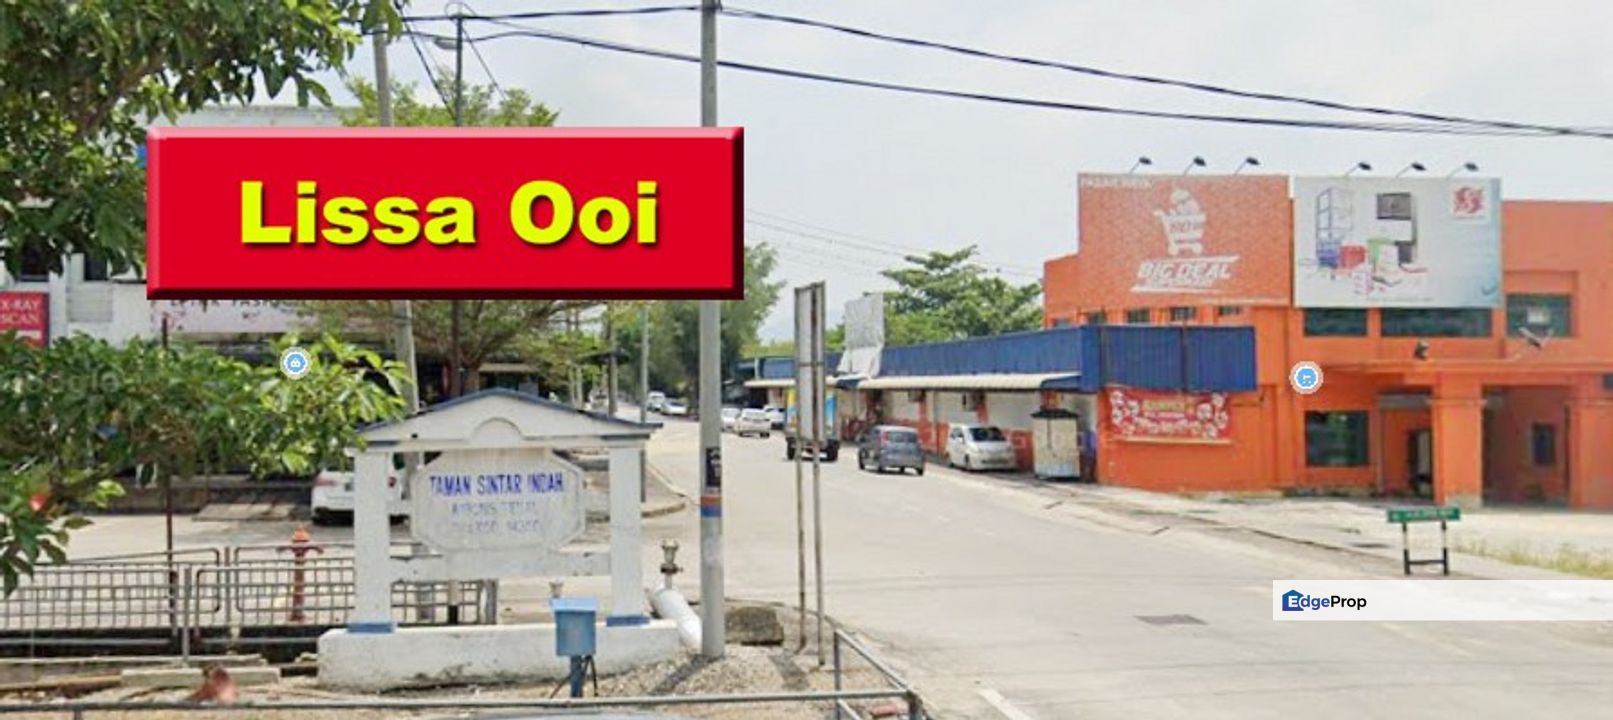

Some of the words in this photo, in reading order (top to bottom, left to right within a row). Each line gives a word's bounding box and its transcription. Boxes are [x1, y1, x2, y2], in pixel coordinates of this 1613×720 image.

[1137, 262, 1175, 279] BIG
[1176, 262, 1232, 279] DEAL
[430, 475, 472, 496] TAMAN
[477, 474, 522, 495] SINTAR
[527, 472, 564, 493] INDAH
